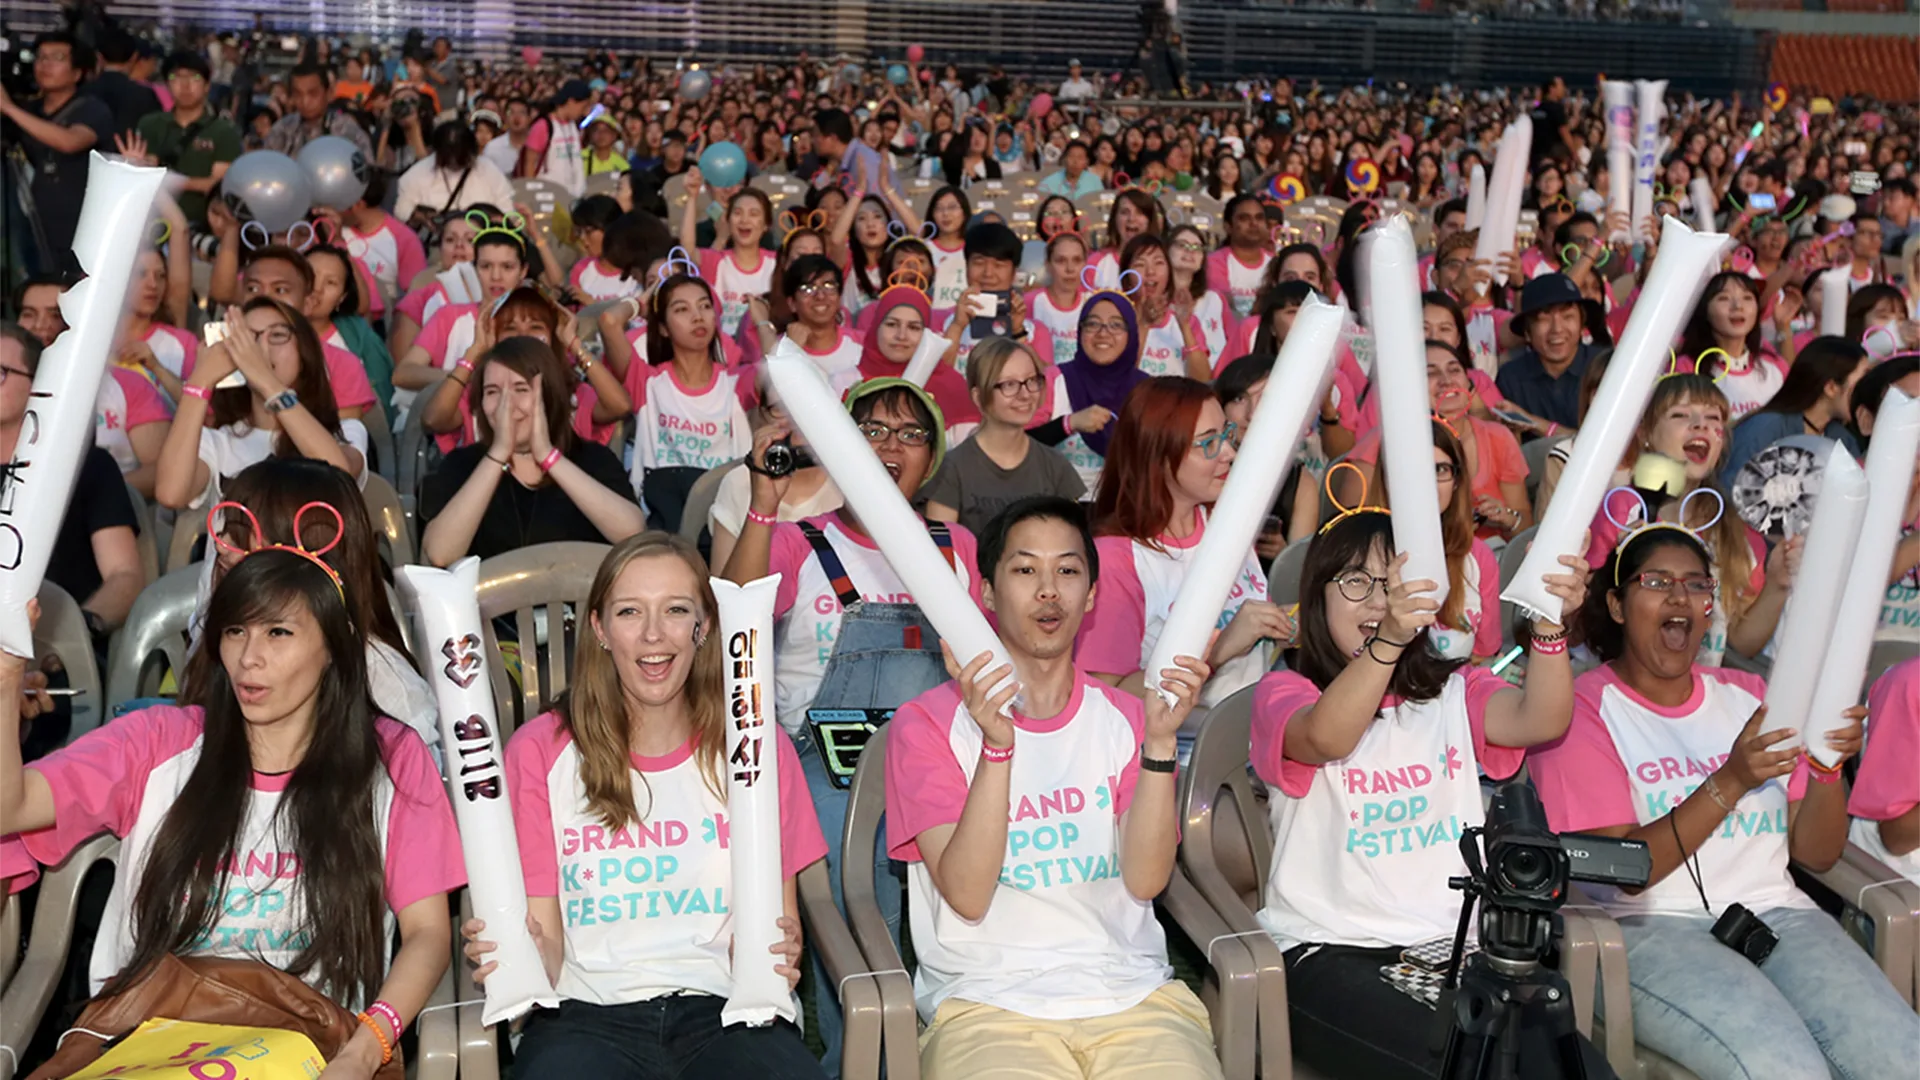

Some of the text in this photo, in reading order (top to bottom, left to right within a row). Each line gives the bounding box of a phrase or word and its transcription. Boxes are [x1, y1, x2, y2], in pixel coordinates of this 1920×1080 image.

[658, 413, 717, 436] GRAND
[812, 711, 863, 720] BLACK BOARD
[1342, 764, 1432, 794] RAND
[562, 820, 689, 856] GRAND
[1708, 808, 1788, 838] IVAL
[214, 848, 304, 879] AND
[567, 887, 729, 928] FESTIVAL
